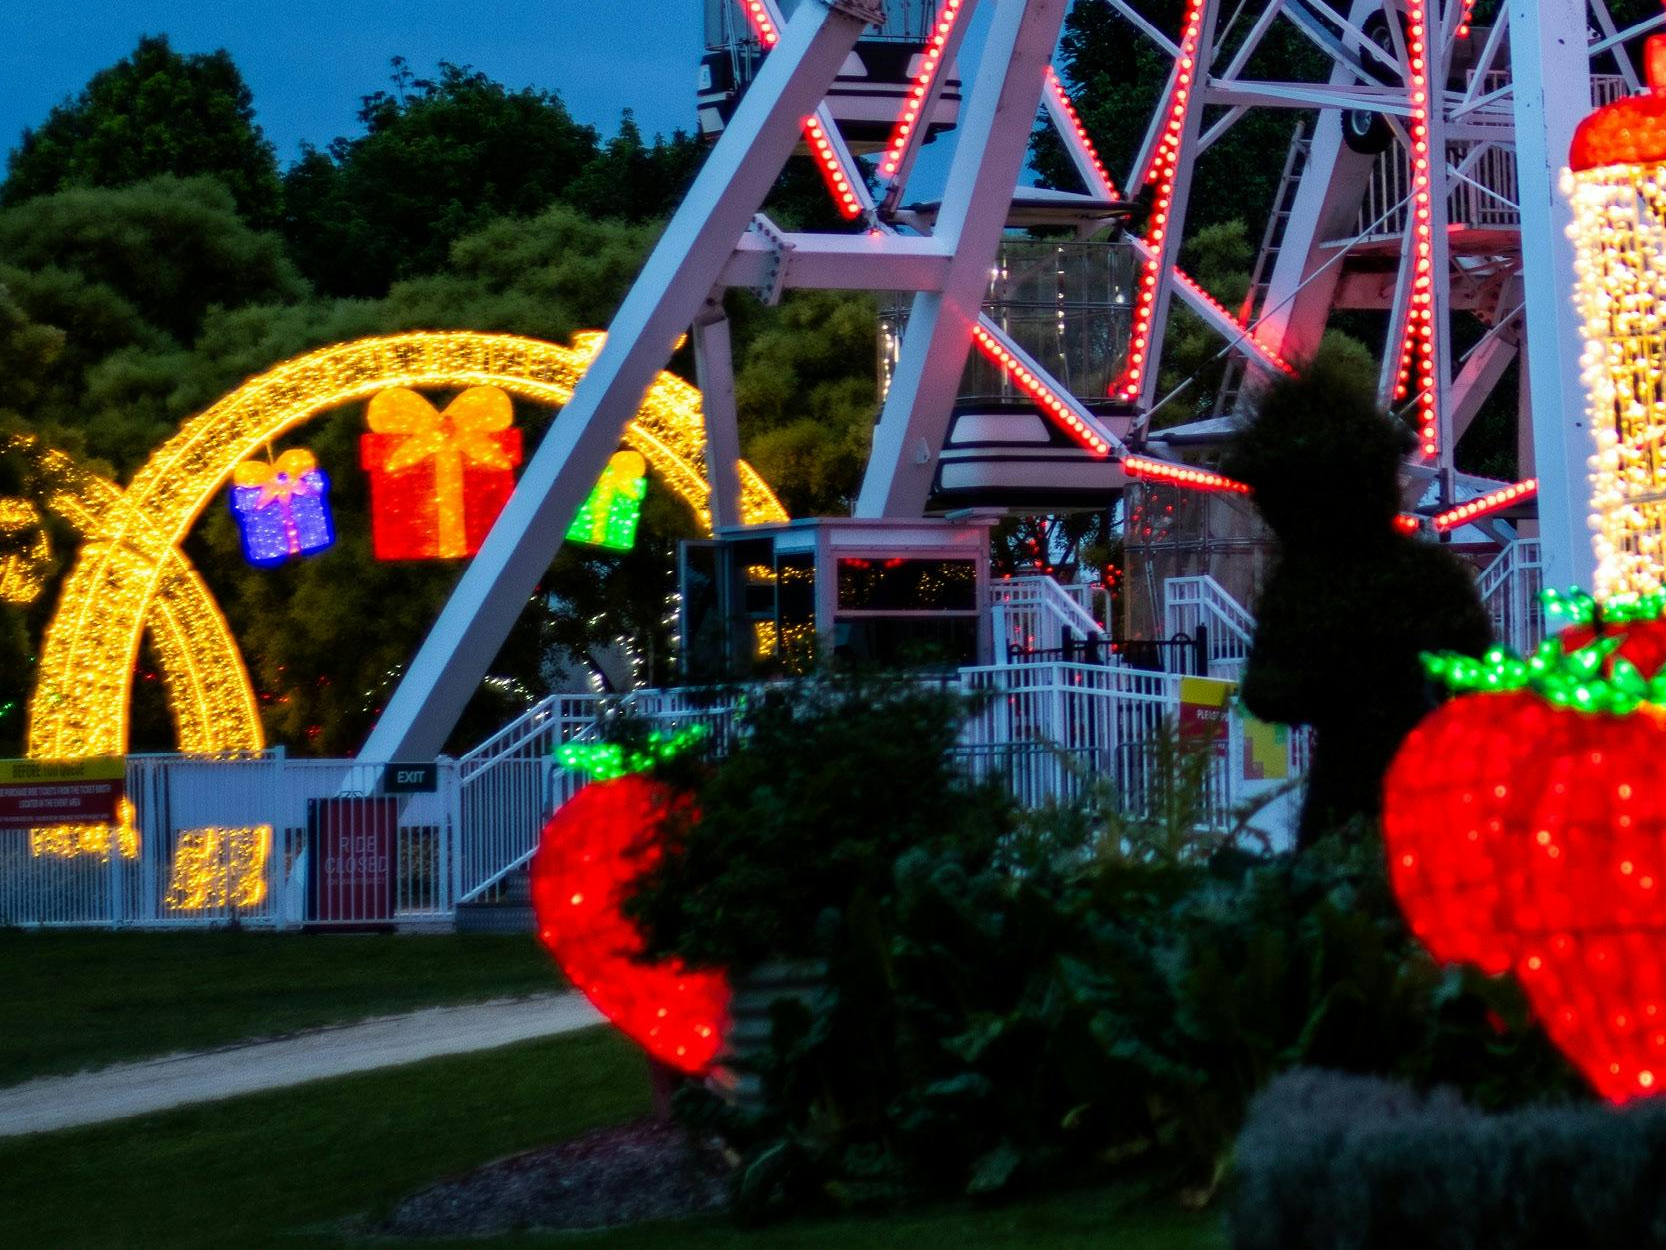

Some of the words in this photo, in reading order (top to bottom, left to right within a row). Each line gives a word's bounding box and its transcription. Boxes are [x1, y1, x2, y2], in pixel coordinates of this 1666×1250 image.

[397, 770, 425, 783] EXIT
[340, 836, 377, 853] RDE
[325, 855, 389, 874] CLOSED
